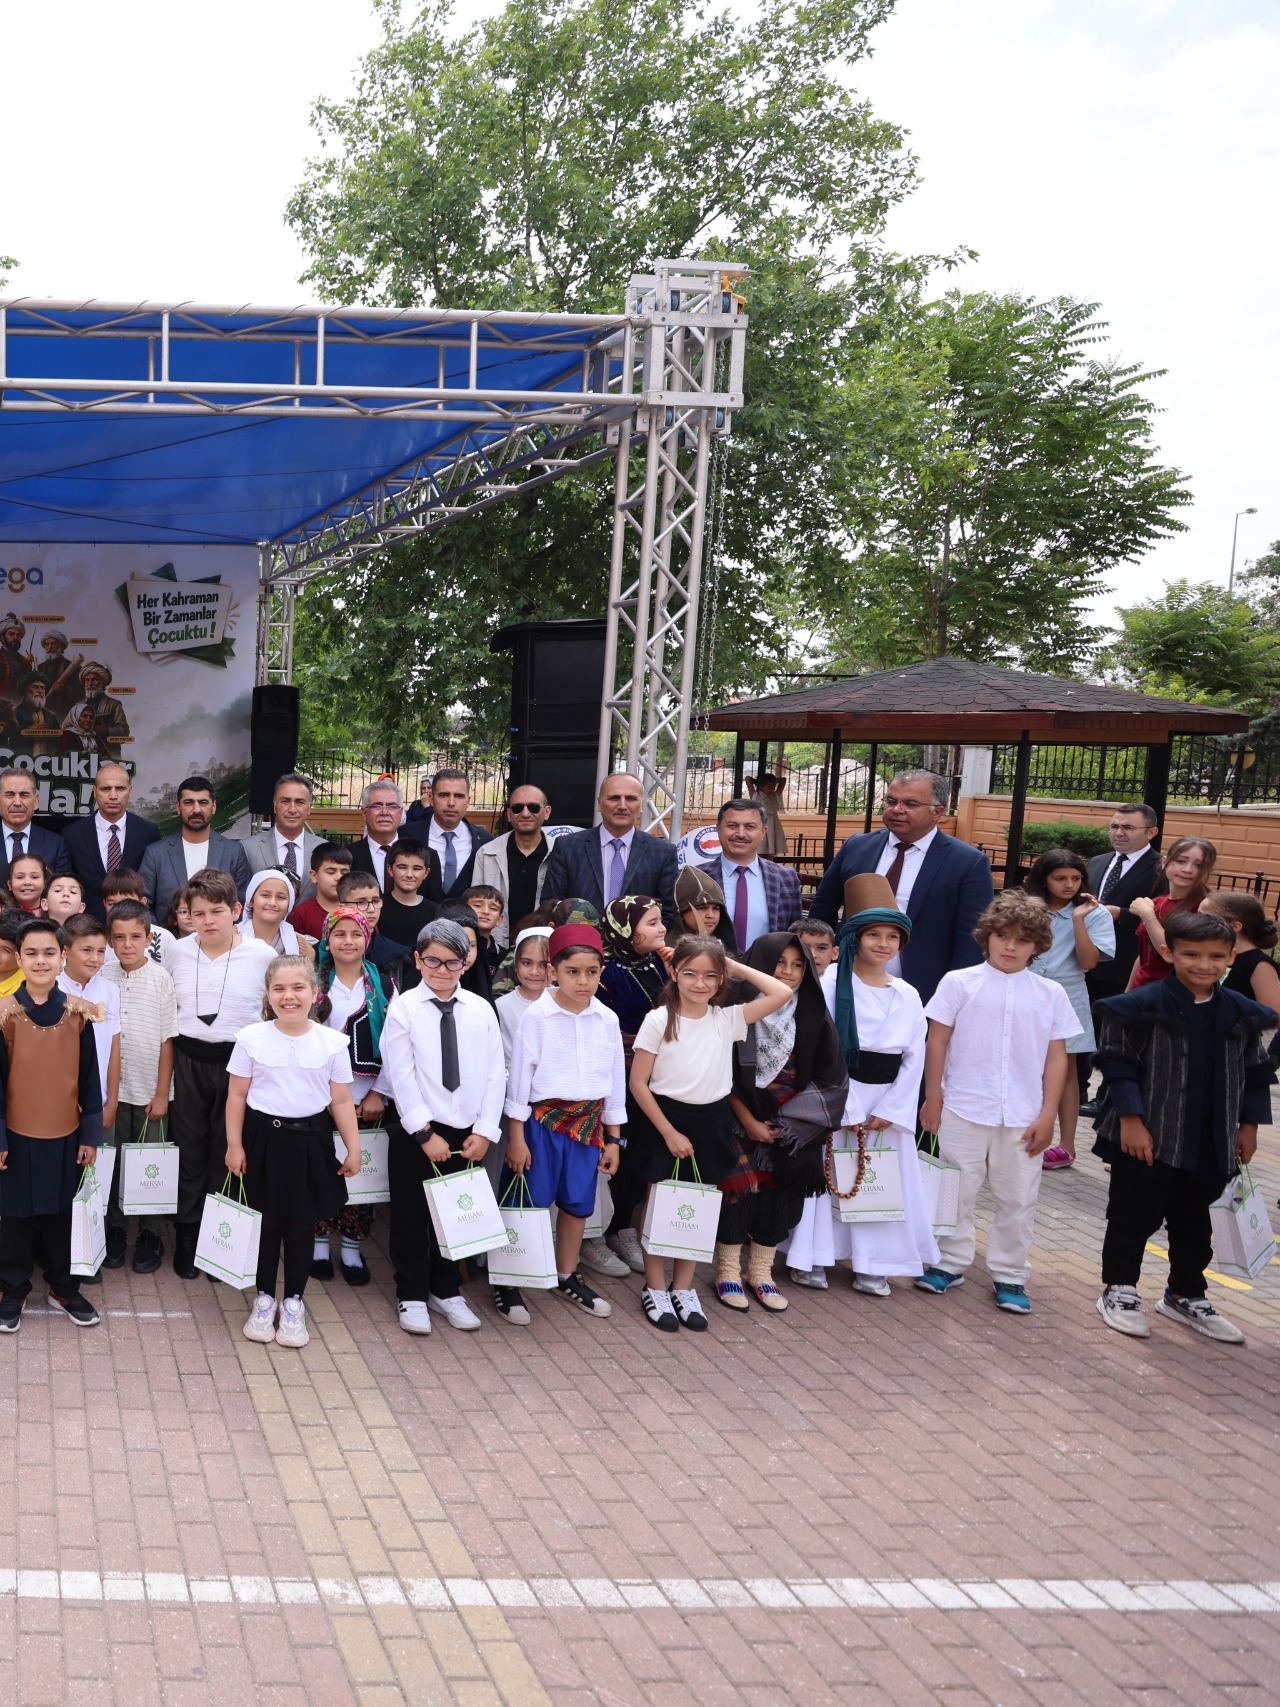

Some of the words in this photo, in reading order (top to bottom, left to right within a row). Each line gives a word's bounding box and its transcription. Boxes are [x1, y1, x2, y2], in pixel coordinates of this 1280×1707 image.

[136, 593, 160, 609] Her
[162, 591, 220, 607] Kahraman
[142, 611, 162, 627] Bir
[163, 605, 217, 625] Zamanlar
[457, 1210, 485, 1224] MERAM
[669, 1220, 699, 1231] MERAM
[211, 1235, 234, 1252] MERAM
[500, 1246, 527, 1255] MERAM
